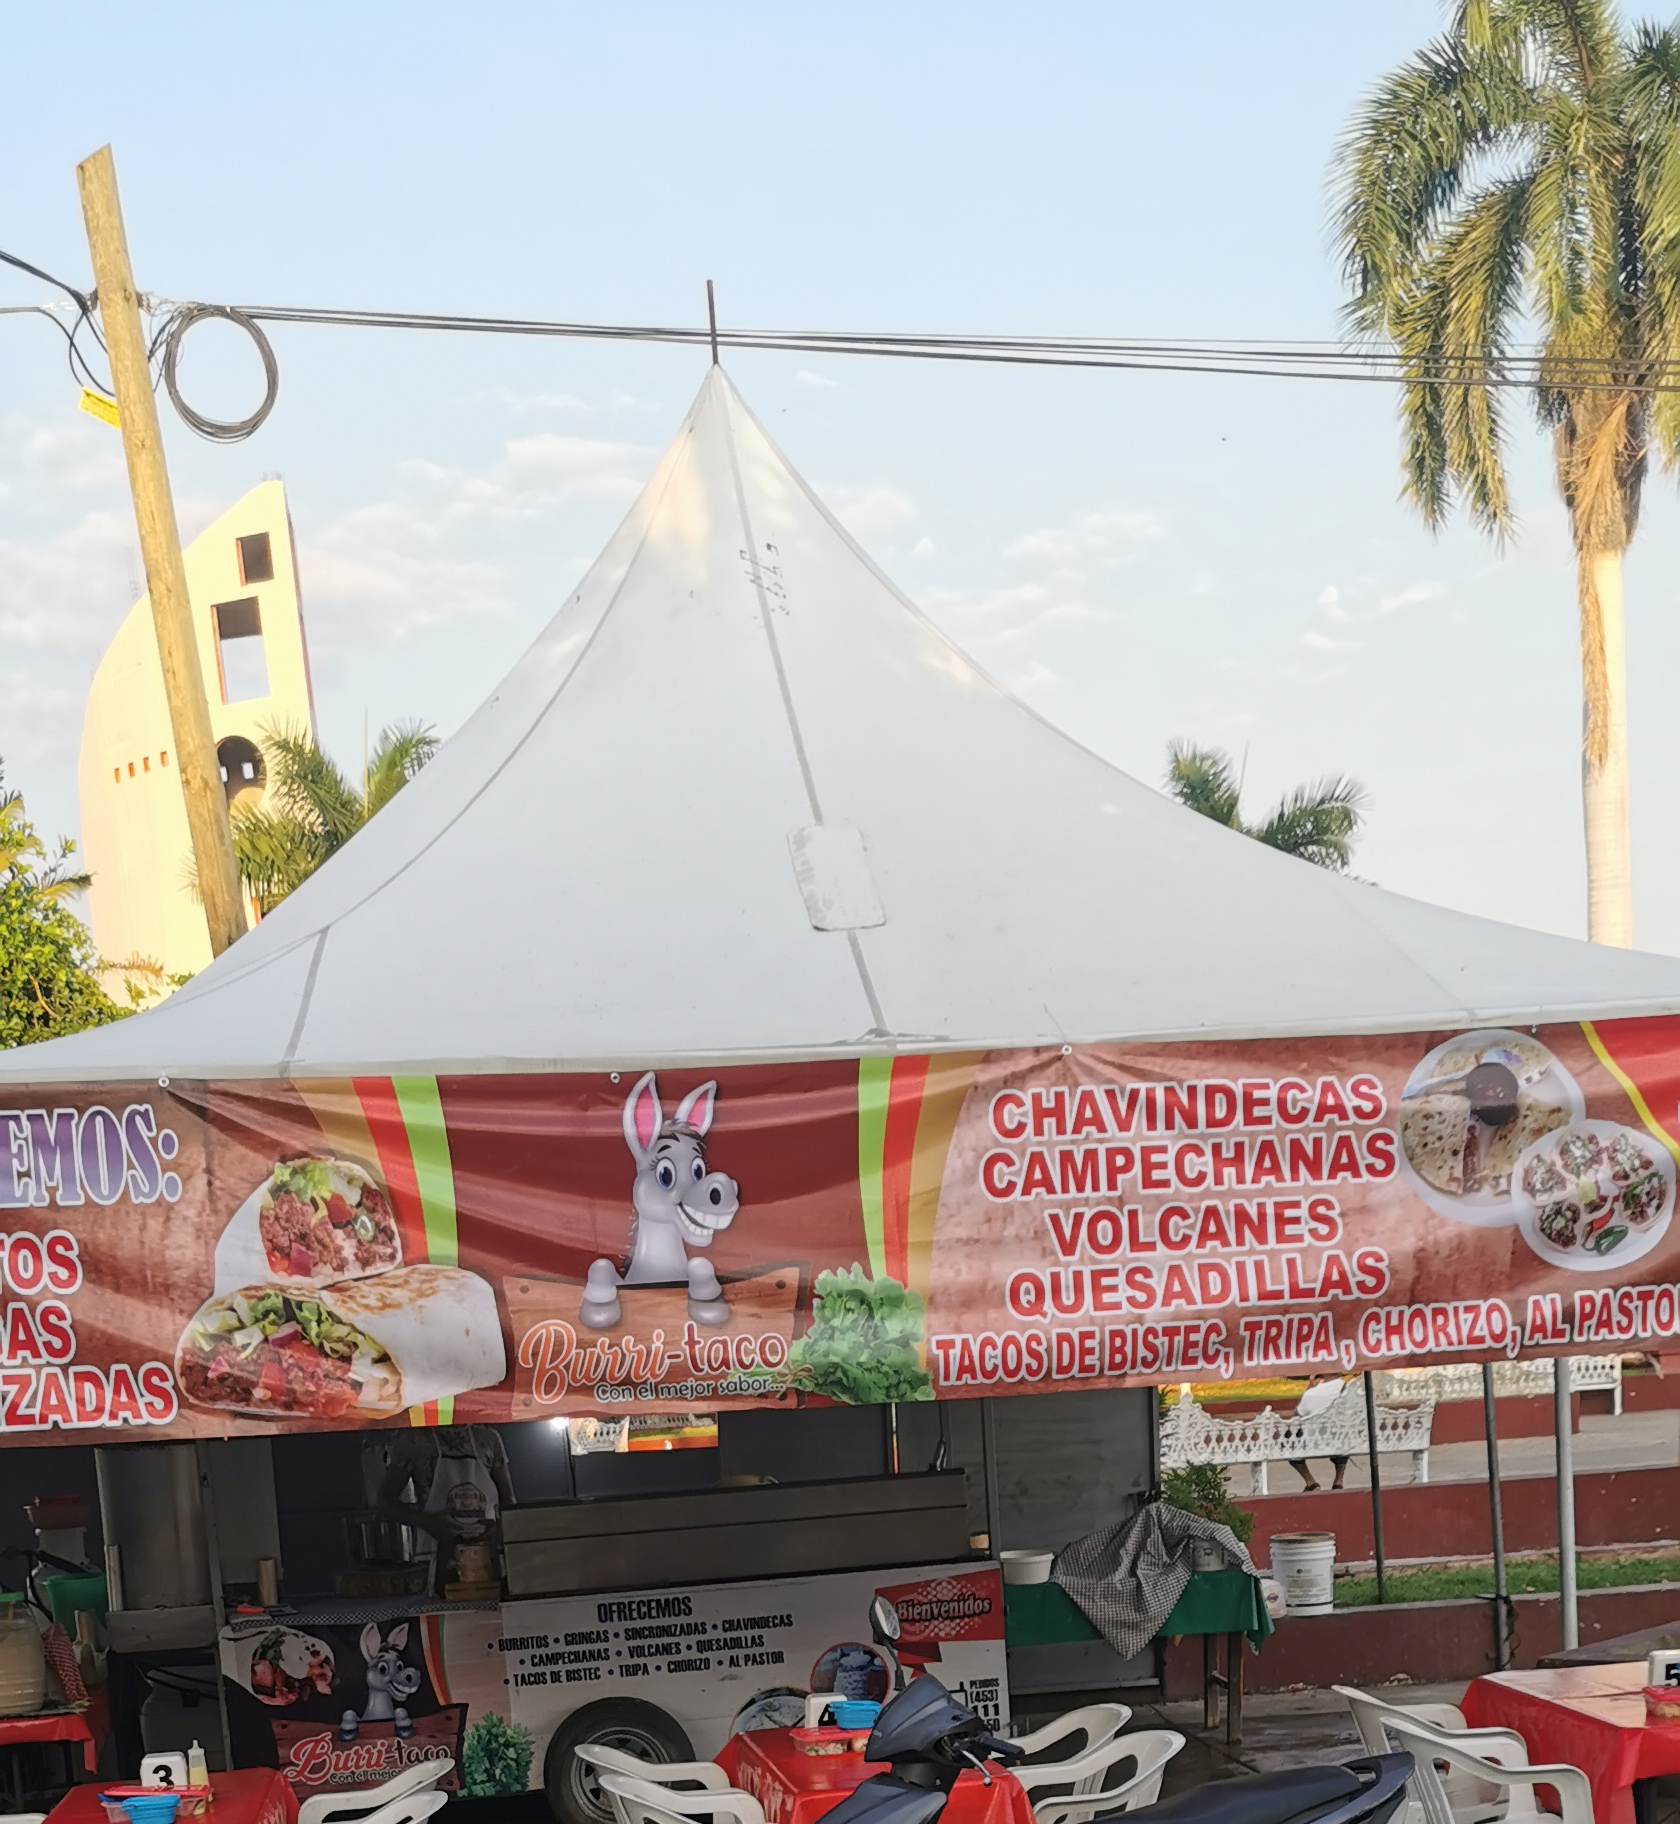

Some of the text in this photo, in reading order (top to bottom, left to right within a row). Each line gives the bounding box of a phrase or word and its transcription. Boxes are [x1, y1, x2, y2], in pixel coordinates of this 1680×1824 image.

[991, 1074, 1383, 1141] CHAVINDECAS
[981, 1127, 1398, 1202] CAMPECHANAS
[1046, 1197, 1342, 1260] VOLCANES
[1005, 1248, 1389, 1322] QUESADILLAS
[933, 1328, 1047, 1386] TACOS
[1051, 1326, 1100, 1379] DE
[1103, 1318, 1233, 1380] BISTEC,
[1359, 1297, 1519, 1360] CHORIZO,
[1524, 1293, 1570, 1347] AL
[1573, 1283, 1680, 1342] PASTO
[519, 1320, 788, 1404] Burri-taco
[593, 1375, 785, 1403] Con el mejor sabor...
[597, 1596, 693, 1623] OFRECEMOS
[897, 1594, 991, 1620] Bienvenidos
[498, 1614, 793, 1652] BURRITOS GRINGAS SINCRONIZADAS CHAVINDECAS
[530, 1635, 765, 1667] CAMPECHANAS VOLCANES QUESADILLAS
[513, 1651, 784, 1687] TACOS DE BISTEC TRIPA CHORIZO AL PASTOR
[1664, 1663, 1680, 1687] 5
[970, 1688, 999, 1704] (453)
[152, 1764, 175, 1790] 3
